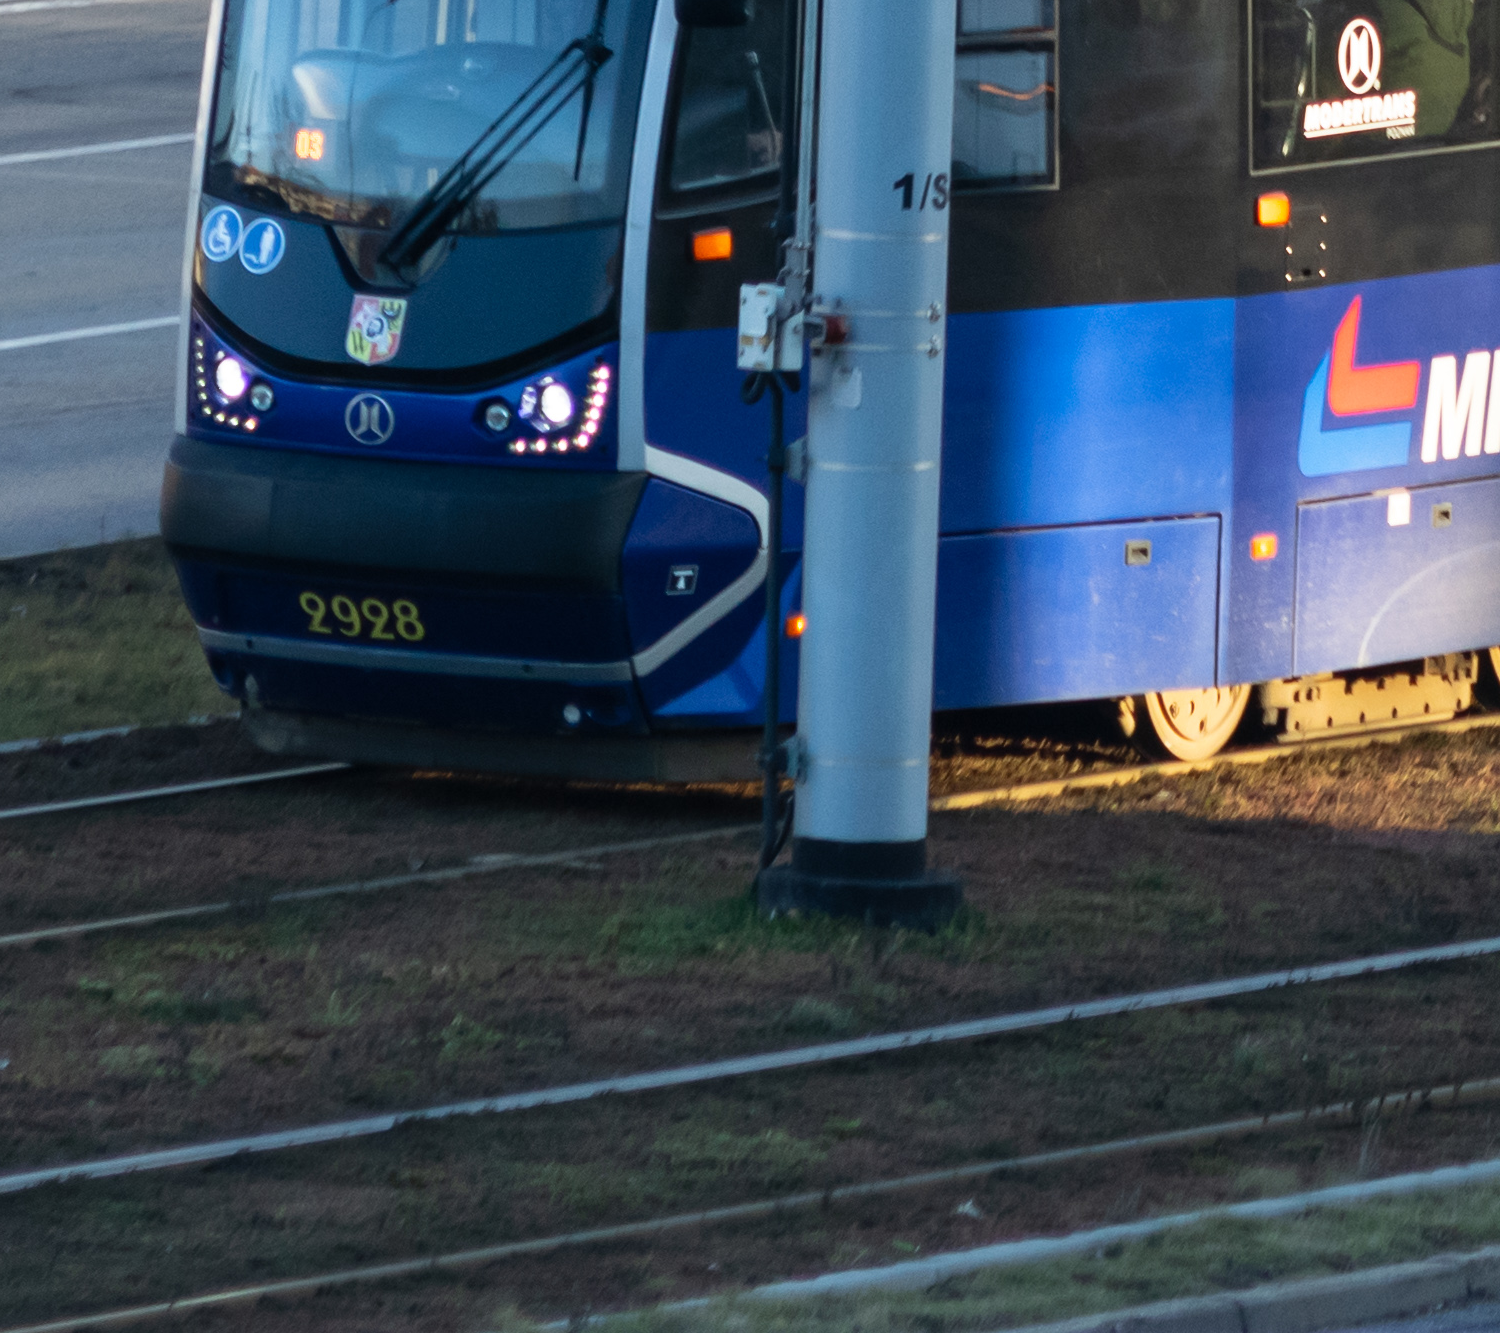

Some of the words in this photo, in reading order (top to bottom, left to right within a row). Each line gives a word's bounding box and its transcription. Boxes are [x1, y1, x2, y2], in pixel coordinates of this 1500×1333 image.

[1303, 90, 1417, 132] MODERTRANS
[295, 129, 324, 161] 03
[298, 591, 426, 642] 2928
